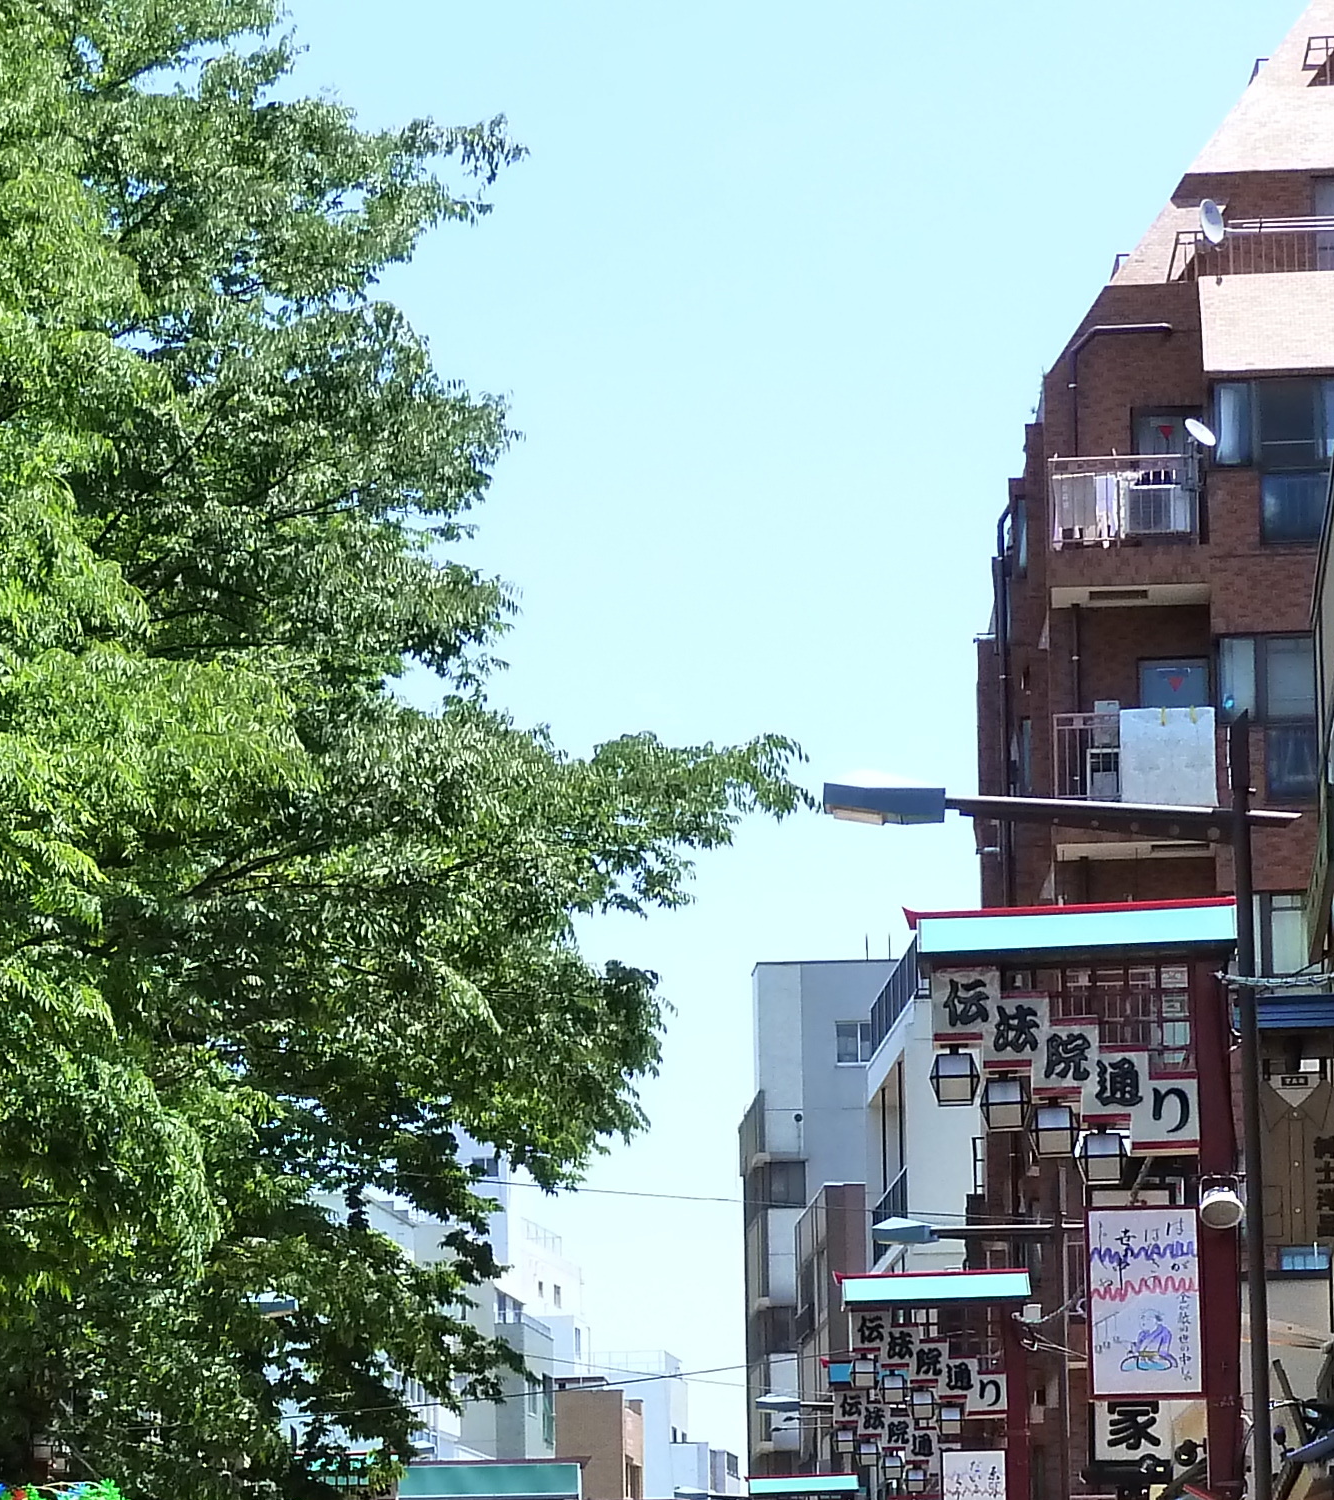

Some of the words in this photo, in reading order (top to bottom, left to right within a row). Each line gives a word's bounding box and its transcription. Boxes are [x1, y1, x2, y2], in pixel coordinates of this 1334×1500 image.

[942, 977, 1191, 1134] 伝法院通り
[857, 1314, 1002, 1408] 伝法院通り
[839, 1393, 935, 1458] 伝法院通
